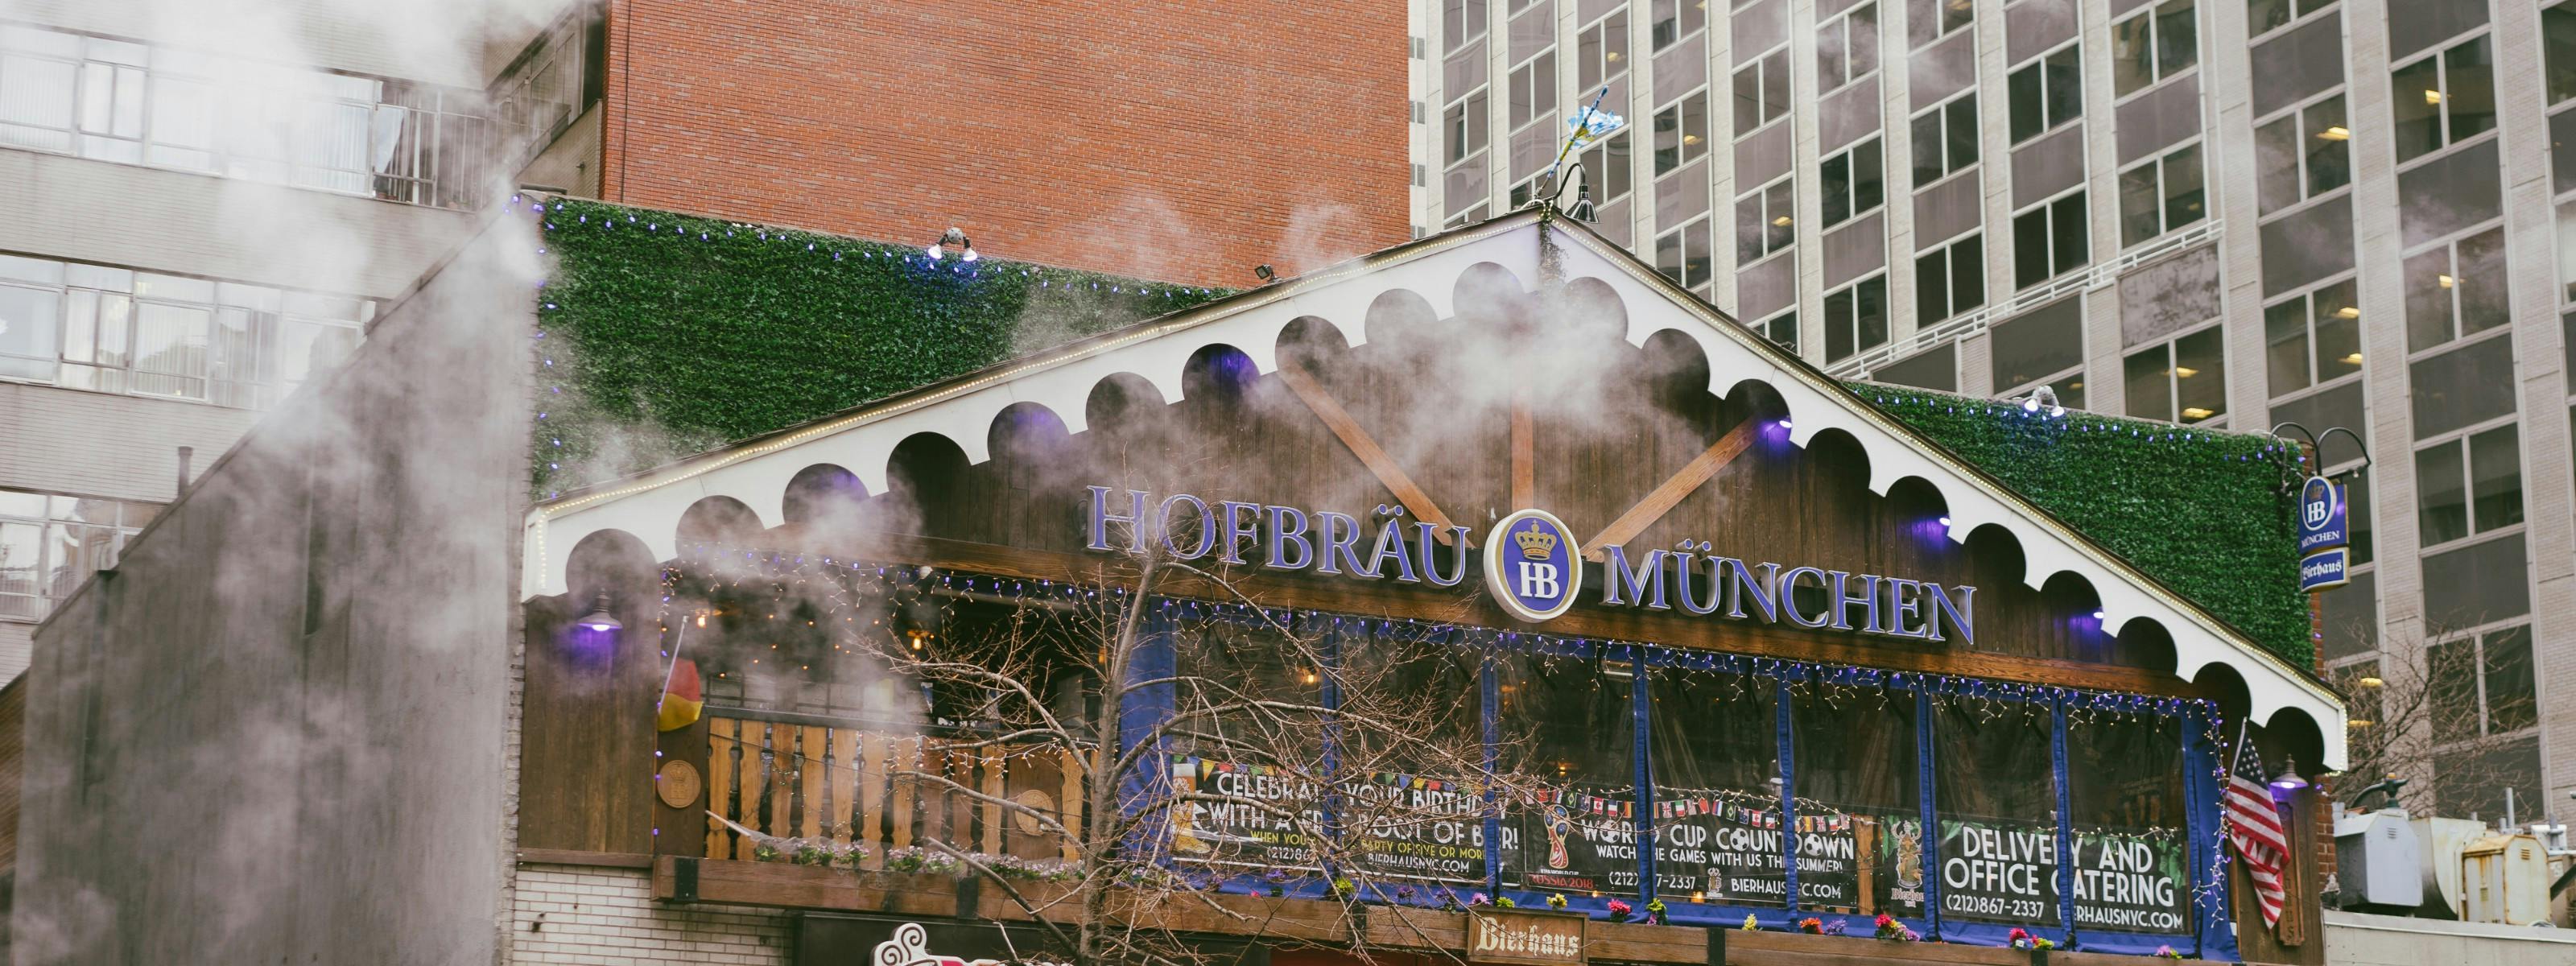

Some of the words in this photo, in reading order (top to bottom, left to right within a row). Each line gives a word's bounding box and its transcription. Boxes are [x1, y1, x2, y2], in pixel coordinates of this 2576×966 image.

[2306, 501, 2326, 523] HB
[1087, 485, 1472, 586] HOFBRÄU
[2301, 530, 2340, 548] MÜNCHEN
[1519, 561, 1559, 599] HB
[2302, 559, 2343, 580] Bierhaus
[1602, 538, 1977, 645] MÜNCHEN
[1413, 789, 1510, 819] BIRTHDY
[1208, 802, 1265, 830] WITH
[1434, 821, 1465, 845] OF
[1472, 825, 1519, 850] BR!
[1670, 824, 1707, 848] CUP
[1250, 830, 1279, 844] WHEN
[1439, 846, 1456, 858] OR
[1596, 844, 1637, 860] WATCH
[1670, 848, 1707, 864] GAMES
[1711, 852, 1742, 866] WITH
[1747, 854, 1762, 867] US
[1766, 855, 1785, 869] THI
[1963, 827, 2083, 867] DELIVEY
[2099, 840, 2153, 873] AND
[1569, 877, 1594, 890] 2018
[1731, 878, 1842, 899] BIERHAUSC.COM
[1945, 857, 2040, 895] OFFICE
[1946, 894, 2045, 918] (212)867-2337
[2057, 903, 2183, 929] RHAUSNYC.COM
[1476, 916, 1580, 956] Bierhaus
